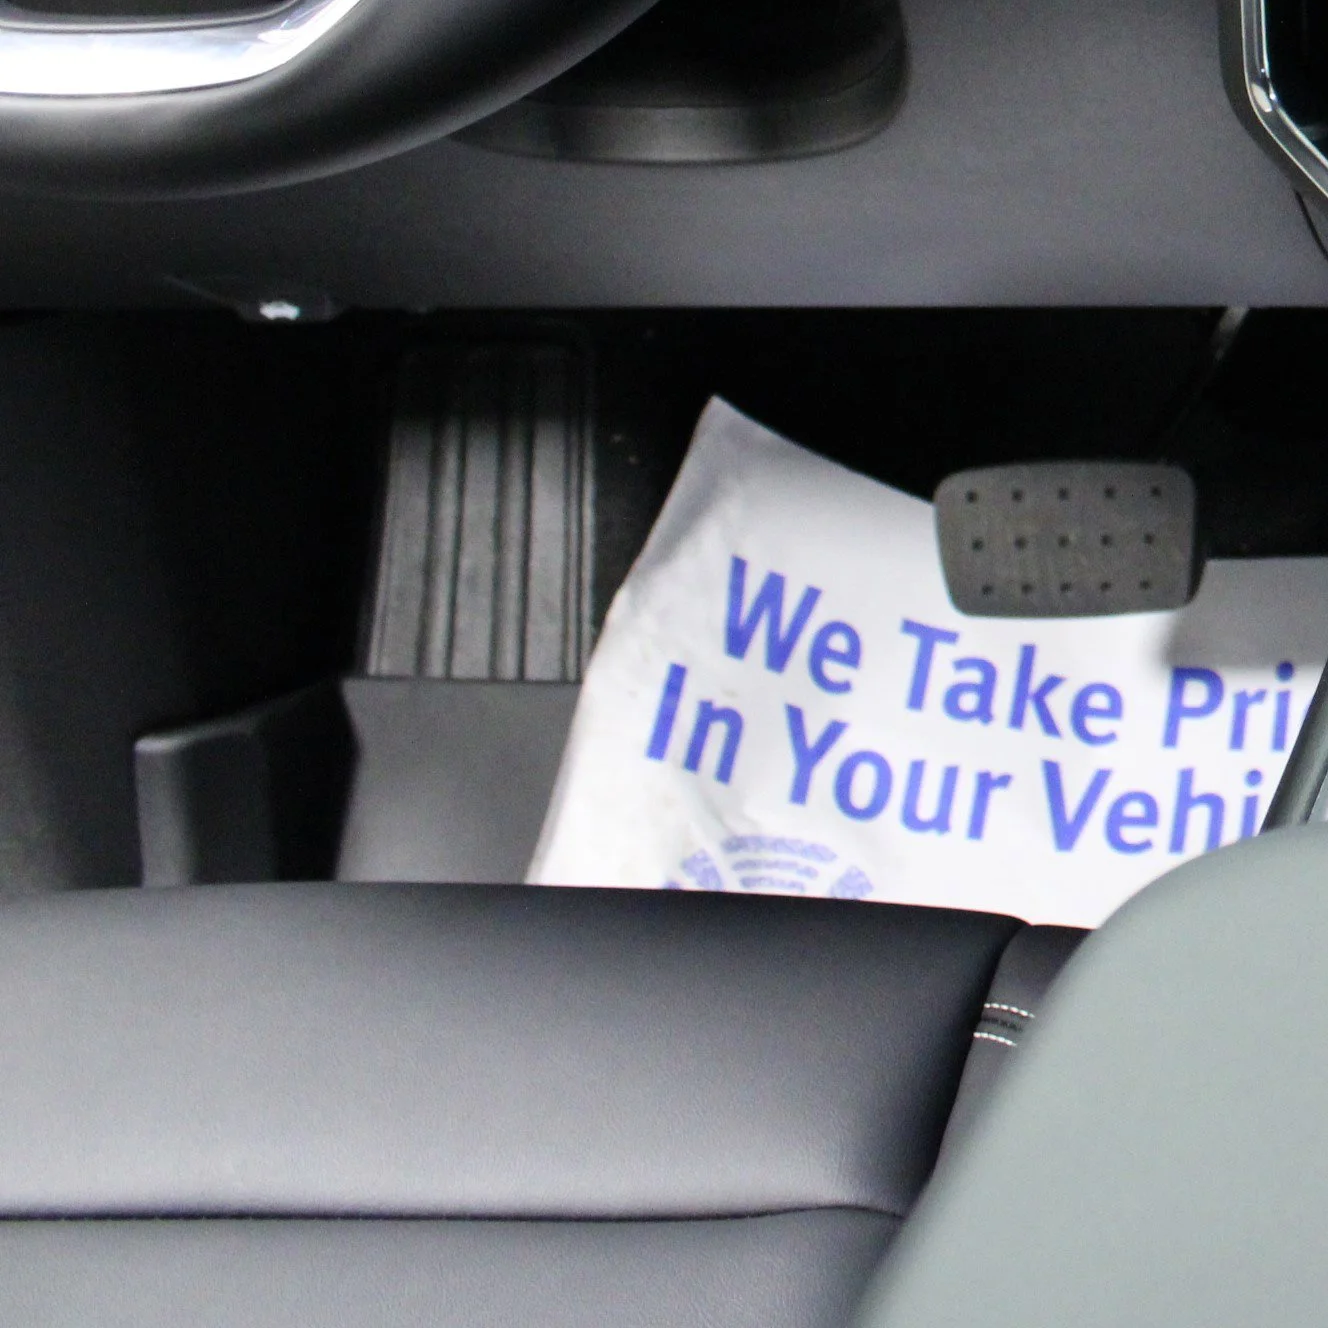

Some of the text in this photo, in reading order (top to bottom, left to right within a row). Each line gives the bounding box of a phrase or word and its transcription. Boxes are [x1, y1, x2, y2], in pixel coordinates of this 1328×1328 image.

[724, 556, 1295, 753] We Take Pri
[645, 662, 1264, 856] In Your Vehi
